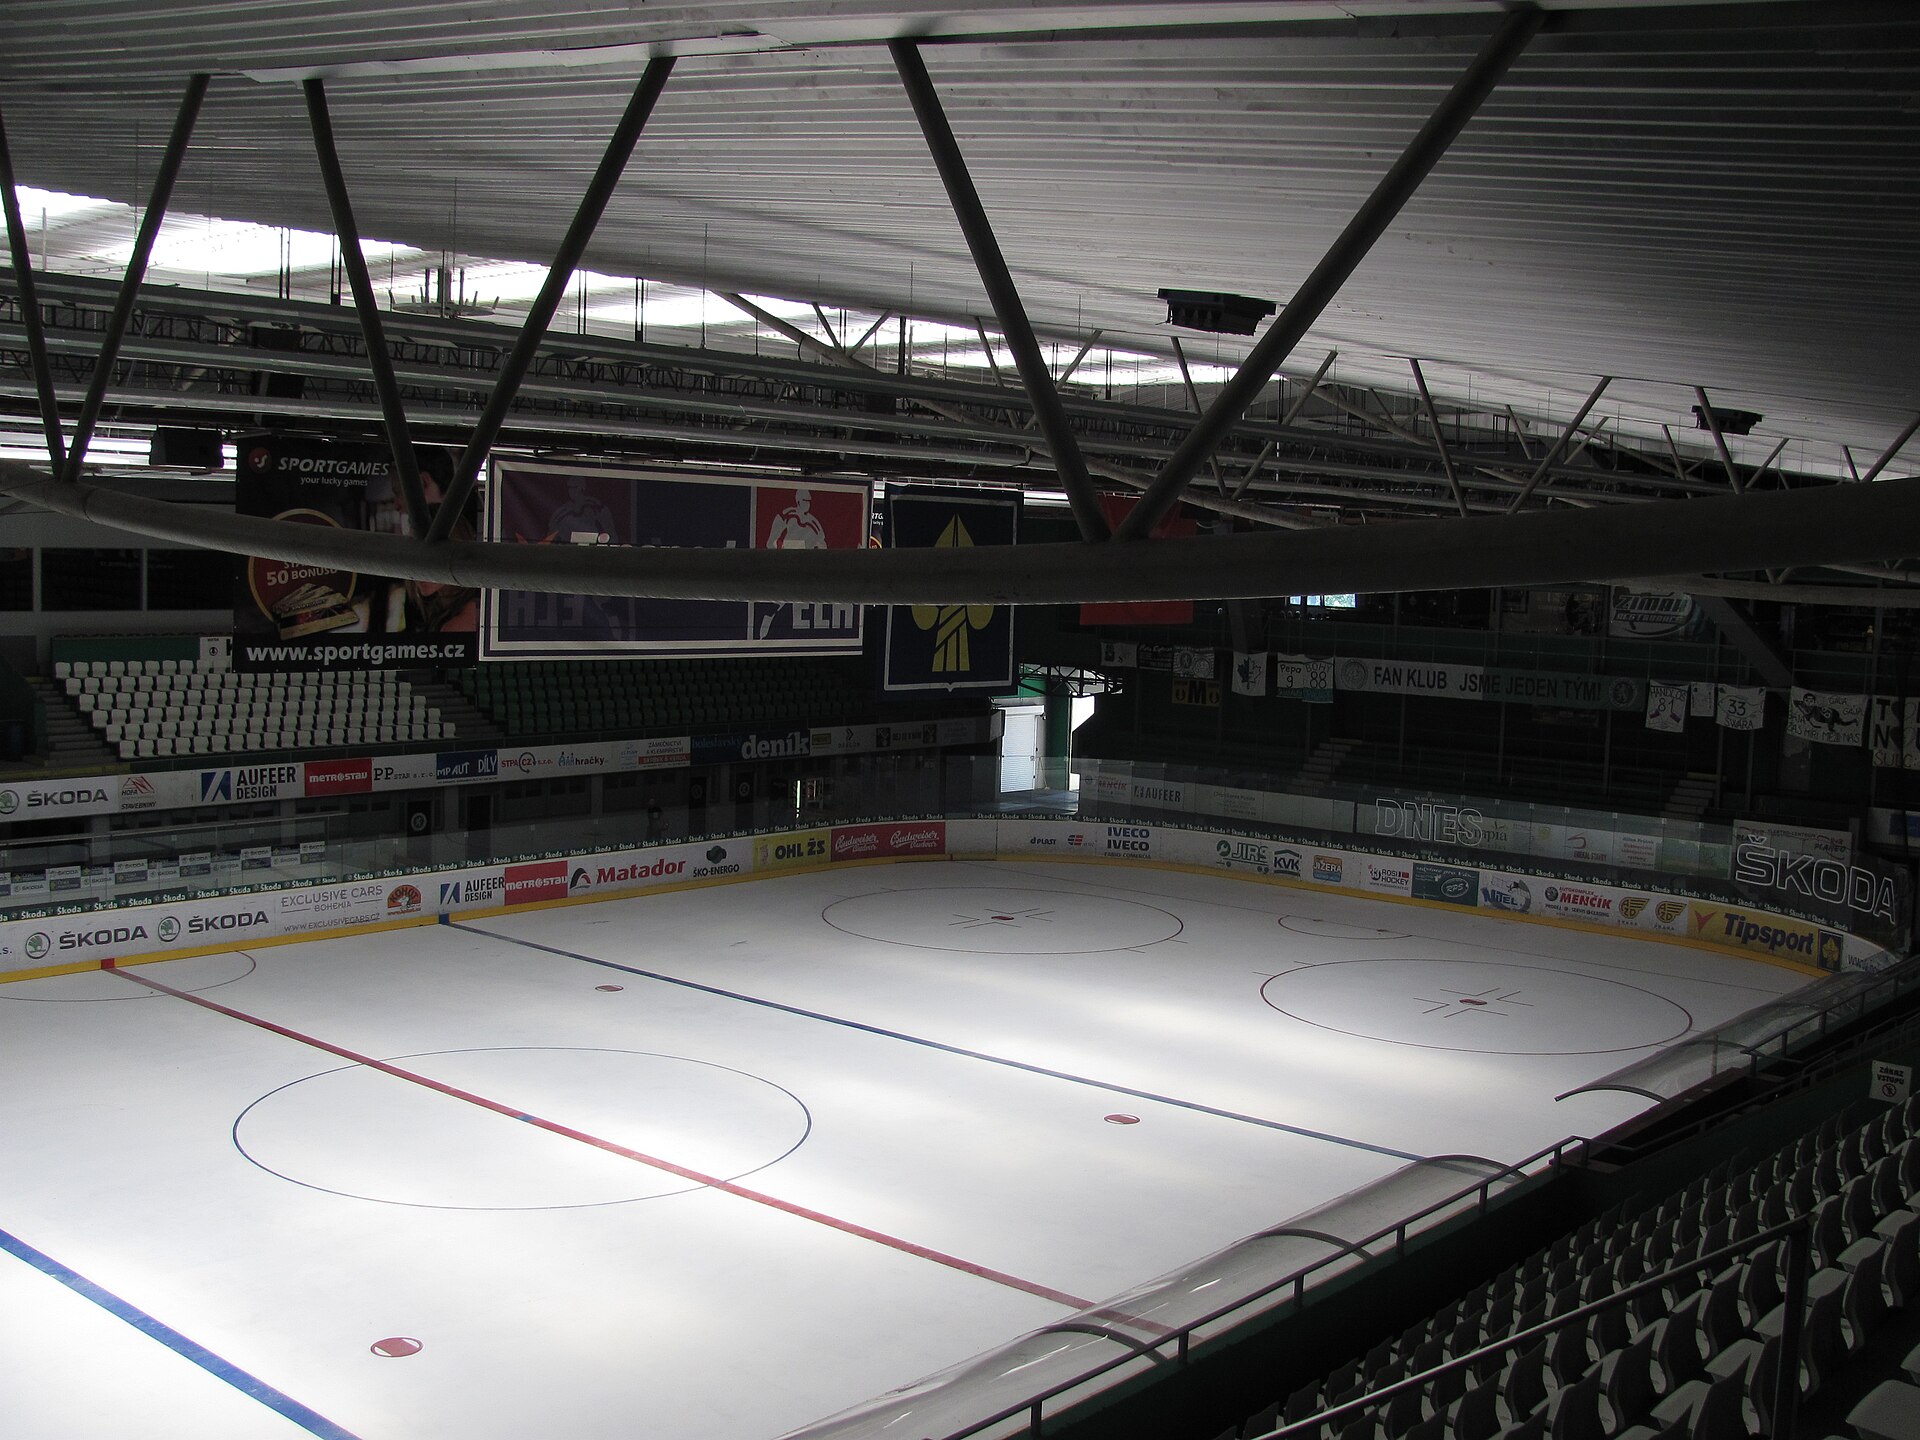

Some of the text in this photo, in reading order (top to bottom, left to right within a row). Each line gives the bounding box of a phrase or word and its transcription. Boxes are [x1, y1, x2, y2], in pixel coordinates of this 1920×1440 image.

[278, 457, 389, 476] SPORTGAMES
[300, 476, 368, 487] your lucky games
[266, 570, 289, 586] 50
[246, 643, 465, 666] www.sportgames.cz
[1310, 671, 1327, 689] 88
[1374, 667, 1401, 685] FAN
[1407, 668, 1447, 688] KLUB
[1460, 672, 1500, 693] JSME
[1506, 676, 1557, 698] JEDEN
[1728, 699, 1746, 716] 33
[742, 731, 810, 760] deník
[478, 754, 498, 774] DÍLY
[575, 756, 605, 766] hračky
[237, 766, 296, 786] AUFEER
[374, 767, 394, 781] PP
[27, 789, 109, 808] ŠKODA
[237, 785, 277, 799] DESIGN
[1145, 785, 1181, 803] AUFEER
[1375, 798, 1483, 847] DNES
[835, 832, 879, 850] Budweiser
[890, 830, 939, 847] Budweiser
[1107, 826, 1150, 838] IVECO
[775, 843, 803, 860] OHL
[807, 838, 825, 856] ŽS
[1107, 839, 1150, 851] IVECO
[597, 859, 686, 884] Matador
[693, 863, 740, 878] ŠKO-ENERGO
[1274, 857, 1300, 871] KVK
[1381, 869, 1398, 877] ROSI
[21, 909, 46, 920] Škoda
[57, 905, 82, 915] Škoda
[94, 900, 118, 911] Škda
[128, 897, 152, 906] Škoda
[162, 891, 186, 902] Škoda
[197, 889, 219, 899] Škoda
[229, 886, 251, 895] Škoda
[260, 882, 282, 892] Škoda
[291, 879, 313, 888] Škoda
[353, 872, 374, 881] Škoda
[383, 868, 403, 877] Škoda
[412, 866, 431, 874] Škoda
[438, 862, 458, 871] Škoda
[466, 860, 485, 868] Škoda
[492, 856, 511, 865] Škoda
[519, 854, 537, 862] Škoda
[545, 851, 563, 859] Škoda
[465, 876, 505, 893] AUFEER
[1381, 876, 1409, 886] HOCKEY
[1735, 835, 1896, 926] ŠKODA
[281, 885, 383, 908] EXCLUSIVE CARS
[465, 891, 492, 902] DESIGN
[1560, 893, 1612, 910] MENČÍK
[314, 902, 351, 912] BOHEMIA
[188, 911, 269, 933] ŠKODA
[284, 912, 381, 933] WWW.EXCLUSIVECARS.CZ
[59, 925, 149, 950] ŠKODA
[1724, 912, 1814, 955] Tipsport
